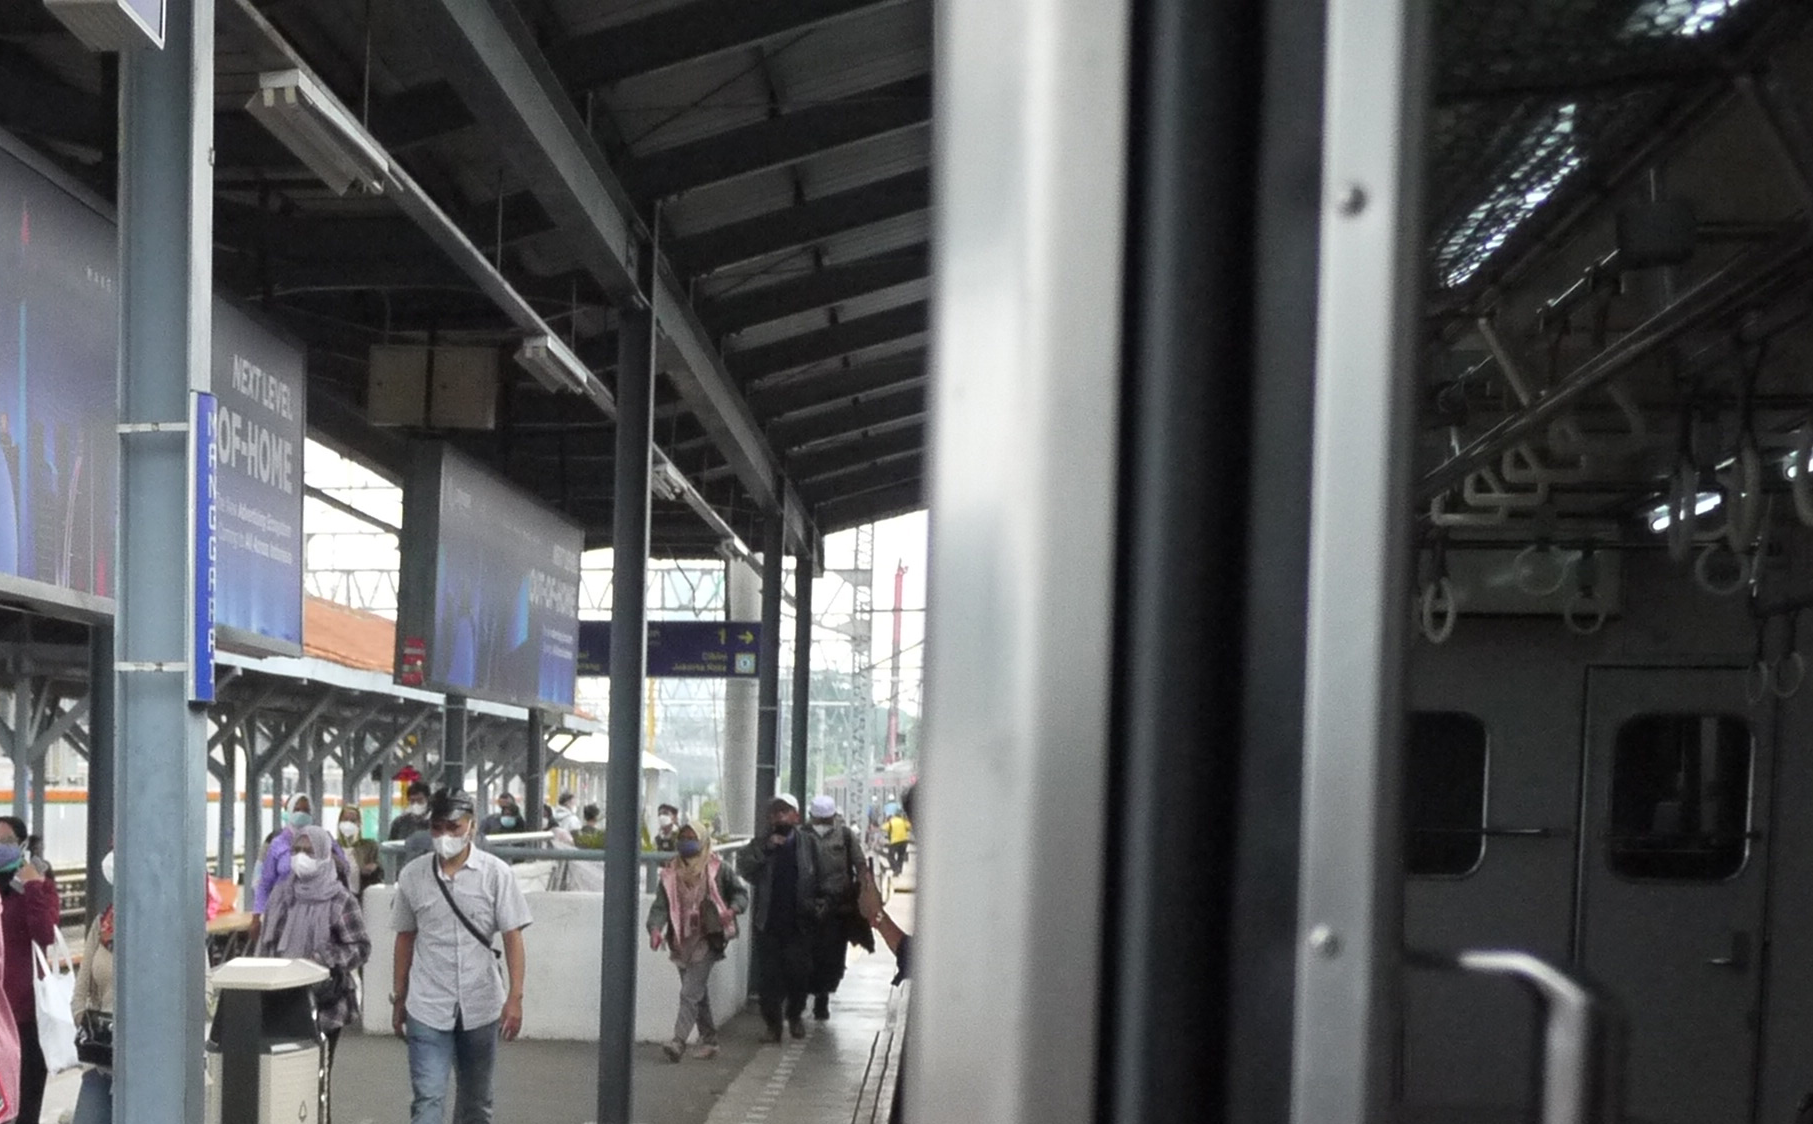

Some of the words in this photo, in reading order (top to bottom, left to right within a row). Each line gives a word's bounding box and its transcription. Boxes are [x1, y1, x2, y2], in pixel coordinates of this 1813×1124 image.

[232, 353, 261, 402] NEXT
[262, 371, 293, 421] LEVEL
[217, 405, 293, 494] OF-HOME
